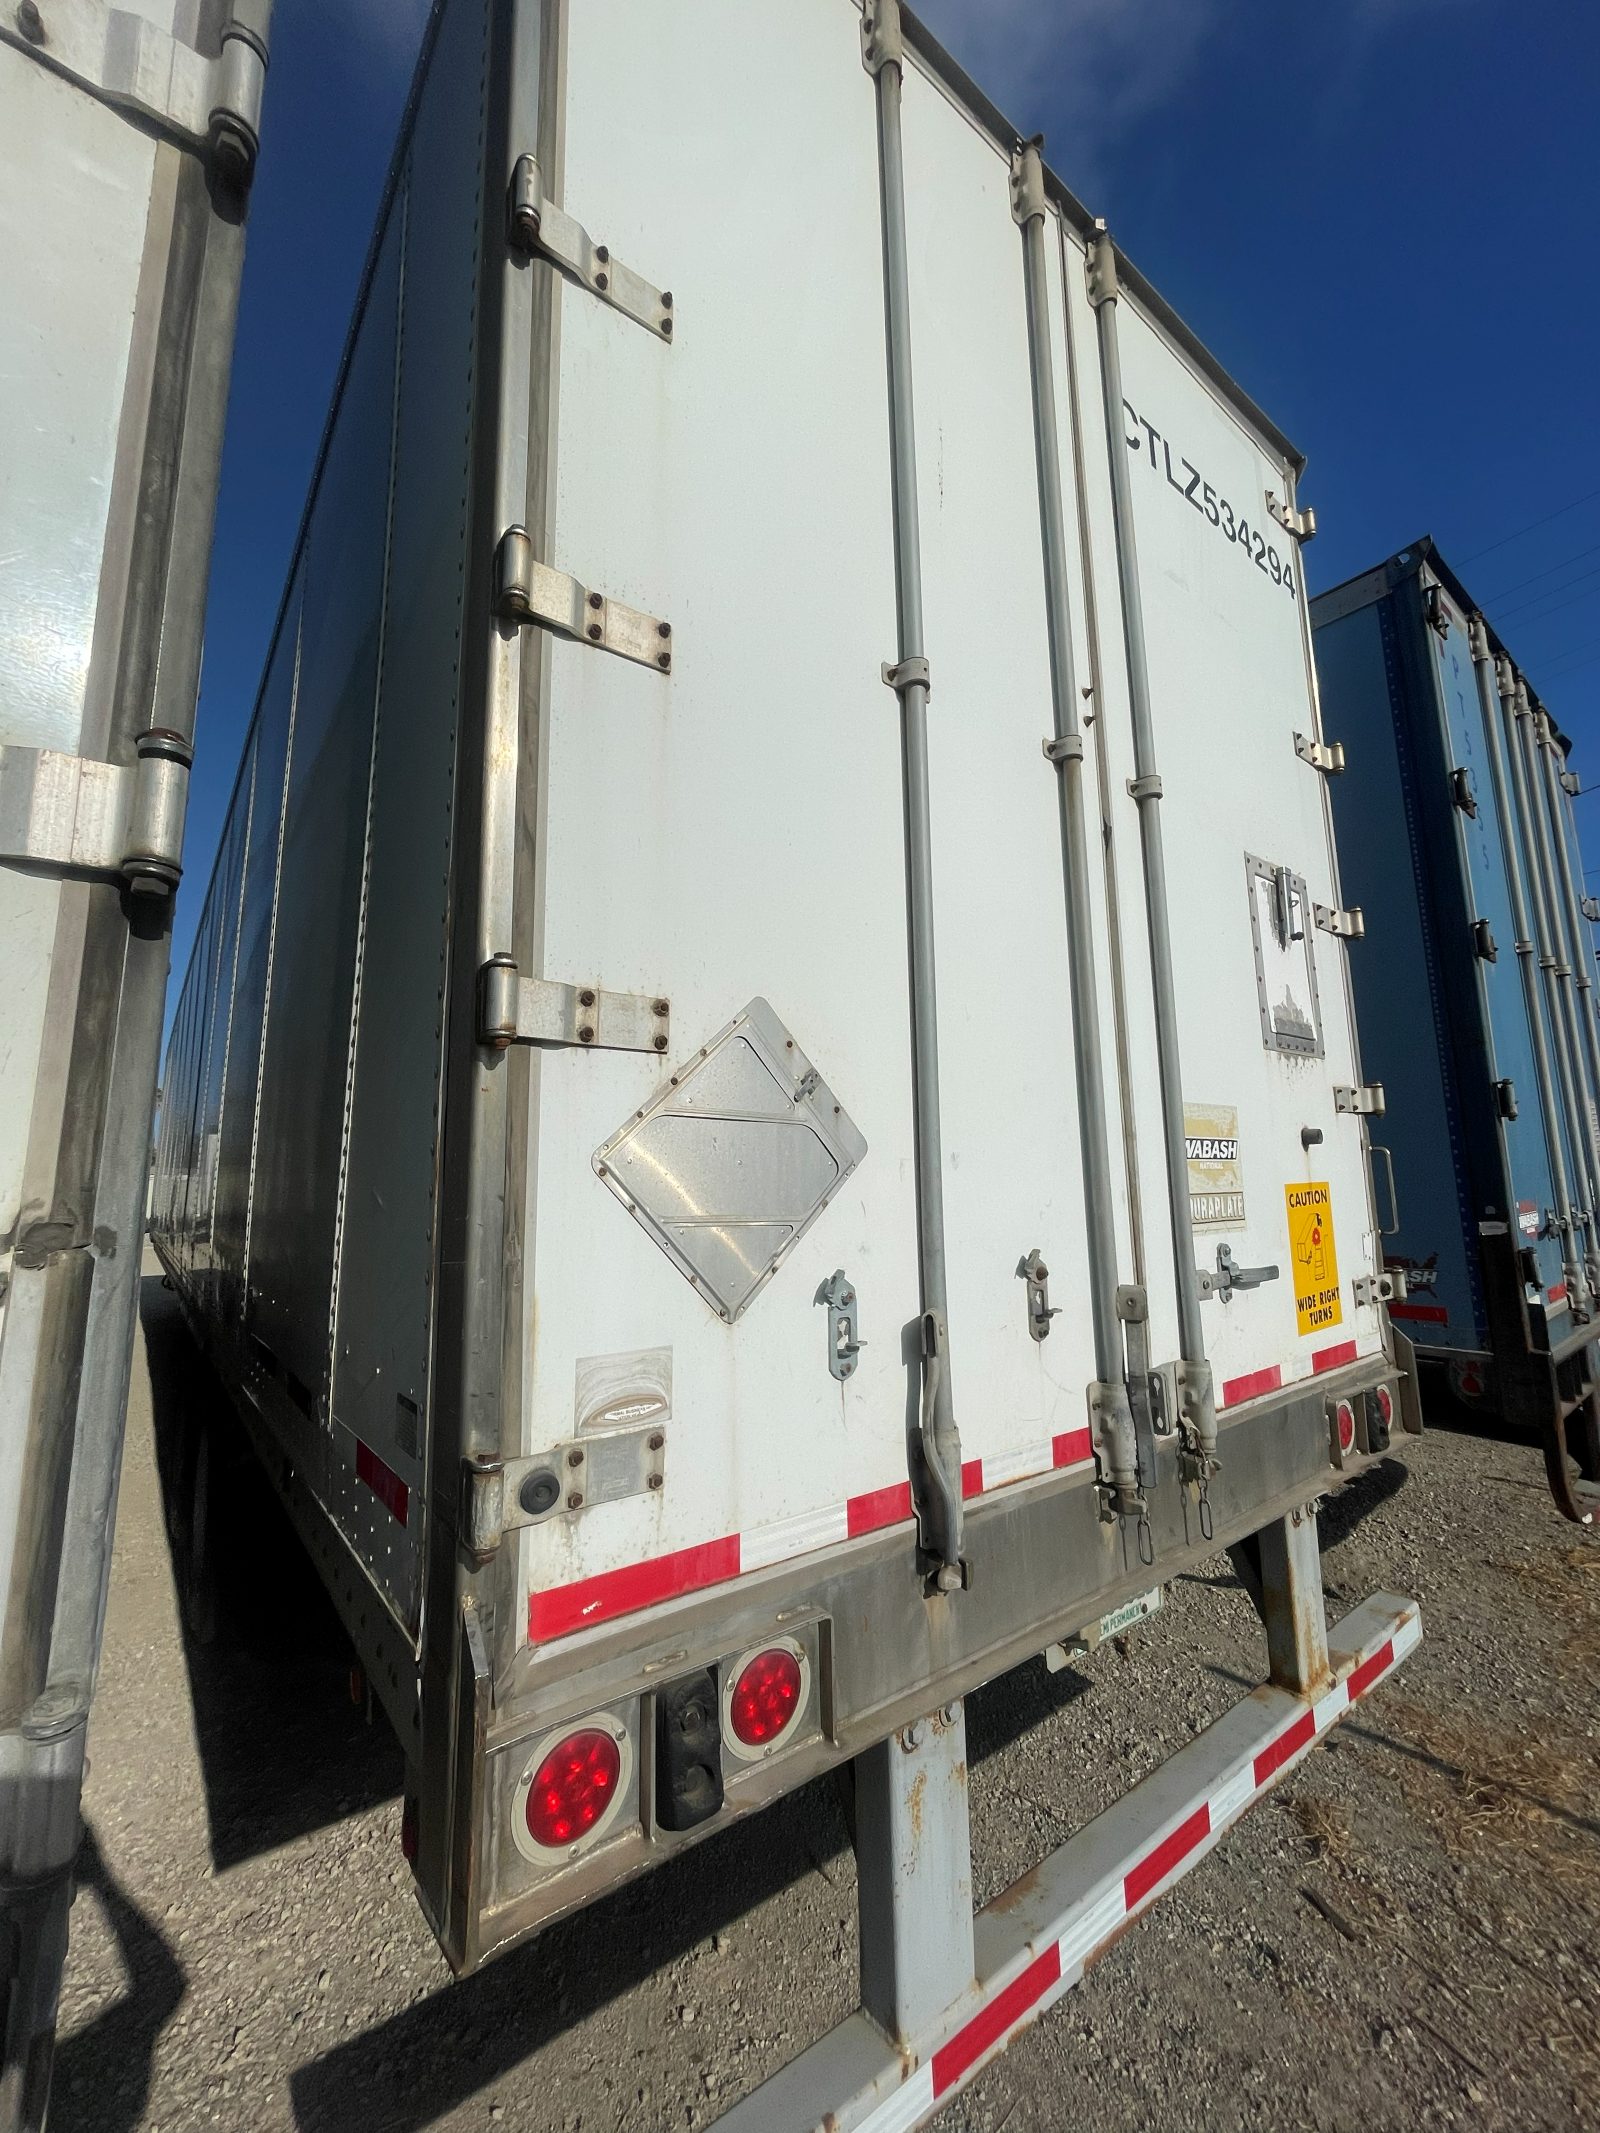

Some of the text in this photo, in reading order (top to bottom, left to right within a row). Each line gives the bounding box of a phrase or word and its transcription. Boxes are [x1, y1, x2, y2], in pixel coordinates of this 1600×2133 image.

[1123, 398, 1296, 600] CTLZ534294
[1289, 1190, 1328, 1208] CAUTION
[1297, 1287, 1340, 1312] WIDE RIGHT
[1309, 1306, 1332, 1326] TURNS
